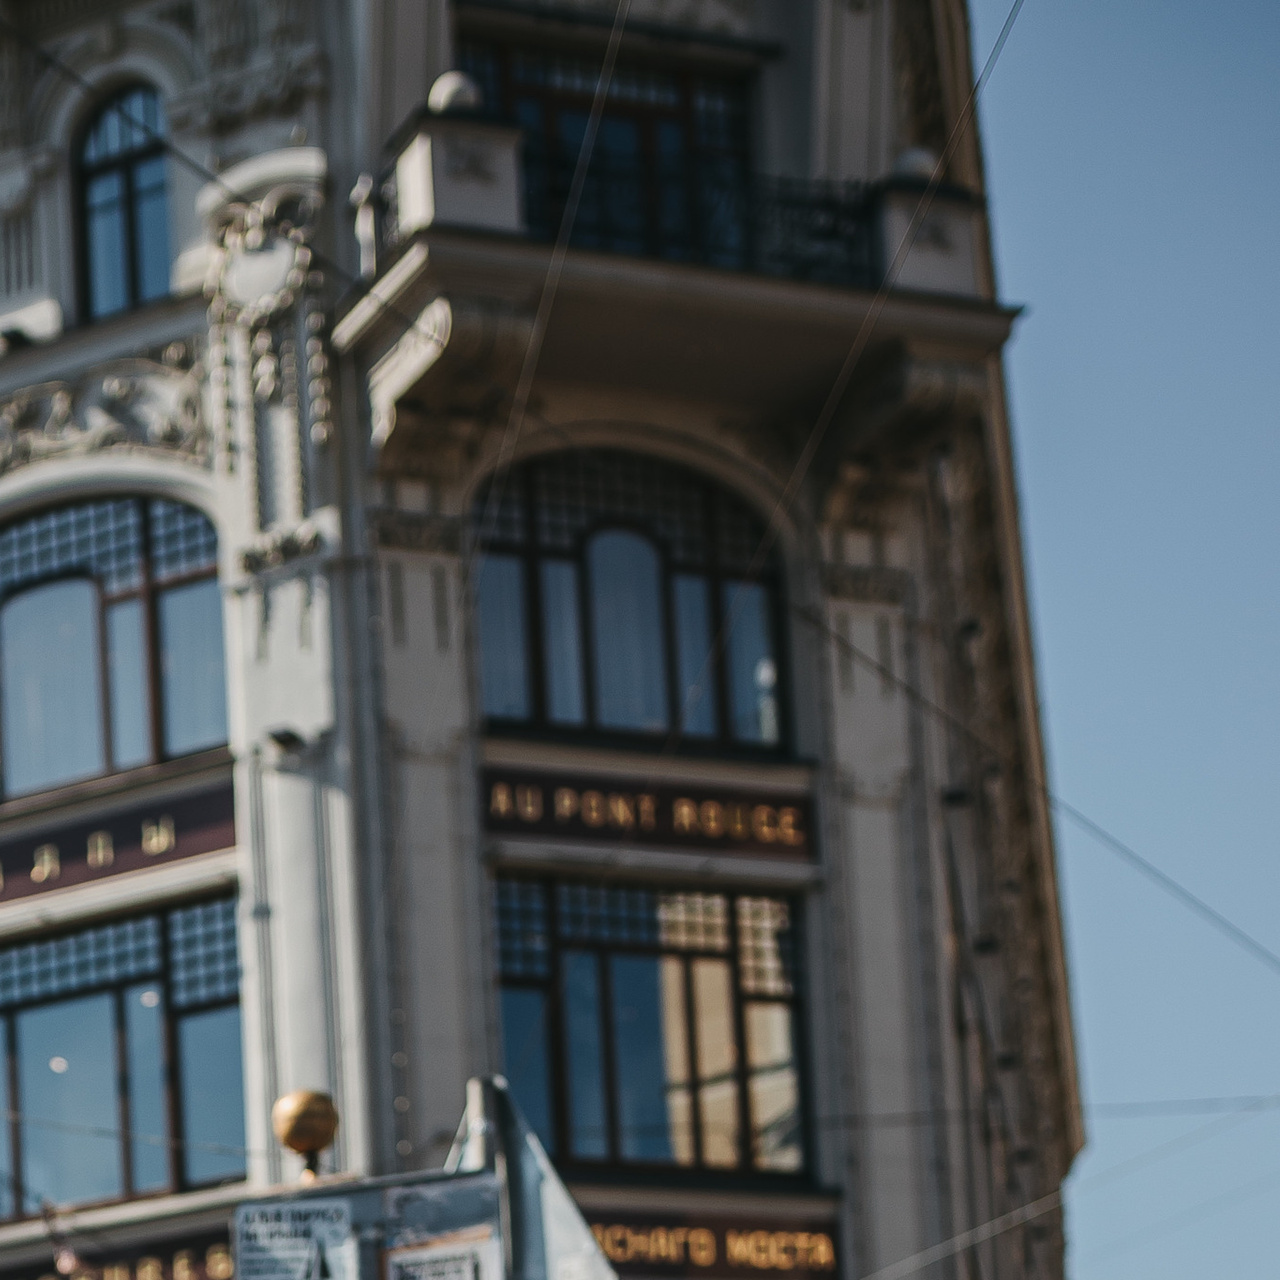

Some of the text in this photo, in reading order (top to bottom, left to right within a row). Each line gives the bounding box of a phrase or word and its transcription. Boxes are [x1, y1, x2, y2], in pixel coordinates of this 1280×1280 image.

[489, 781, 806, 847] AU PONT ROUGE
[591, 1222, 836, 1272] СНАГО МОСТА
